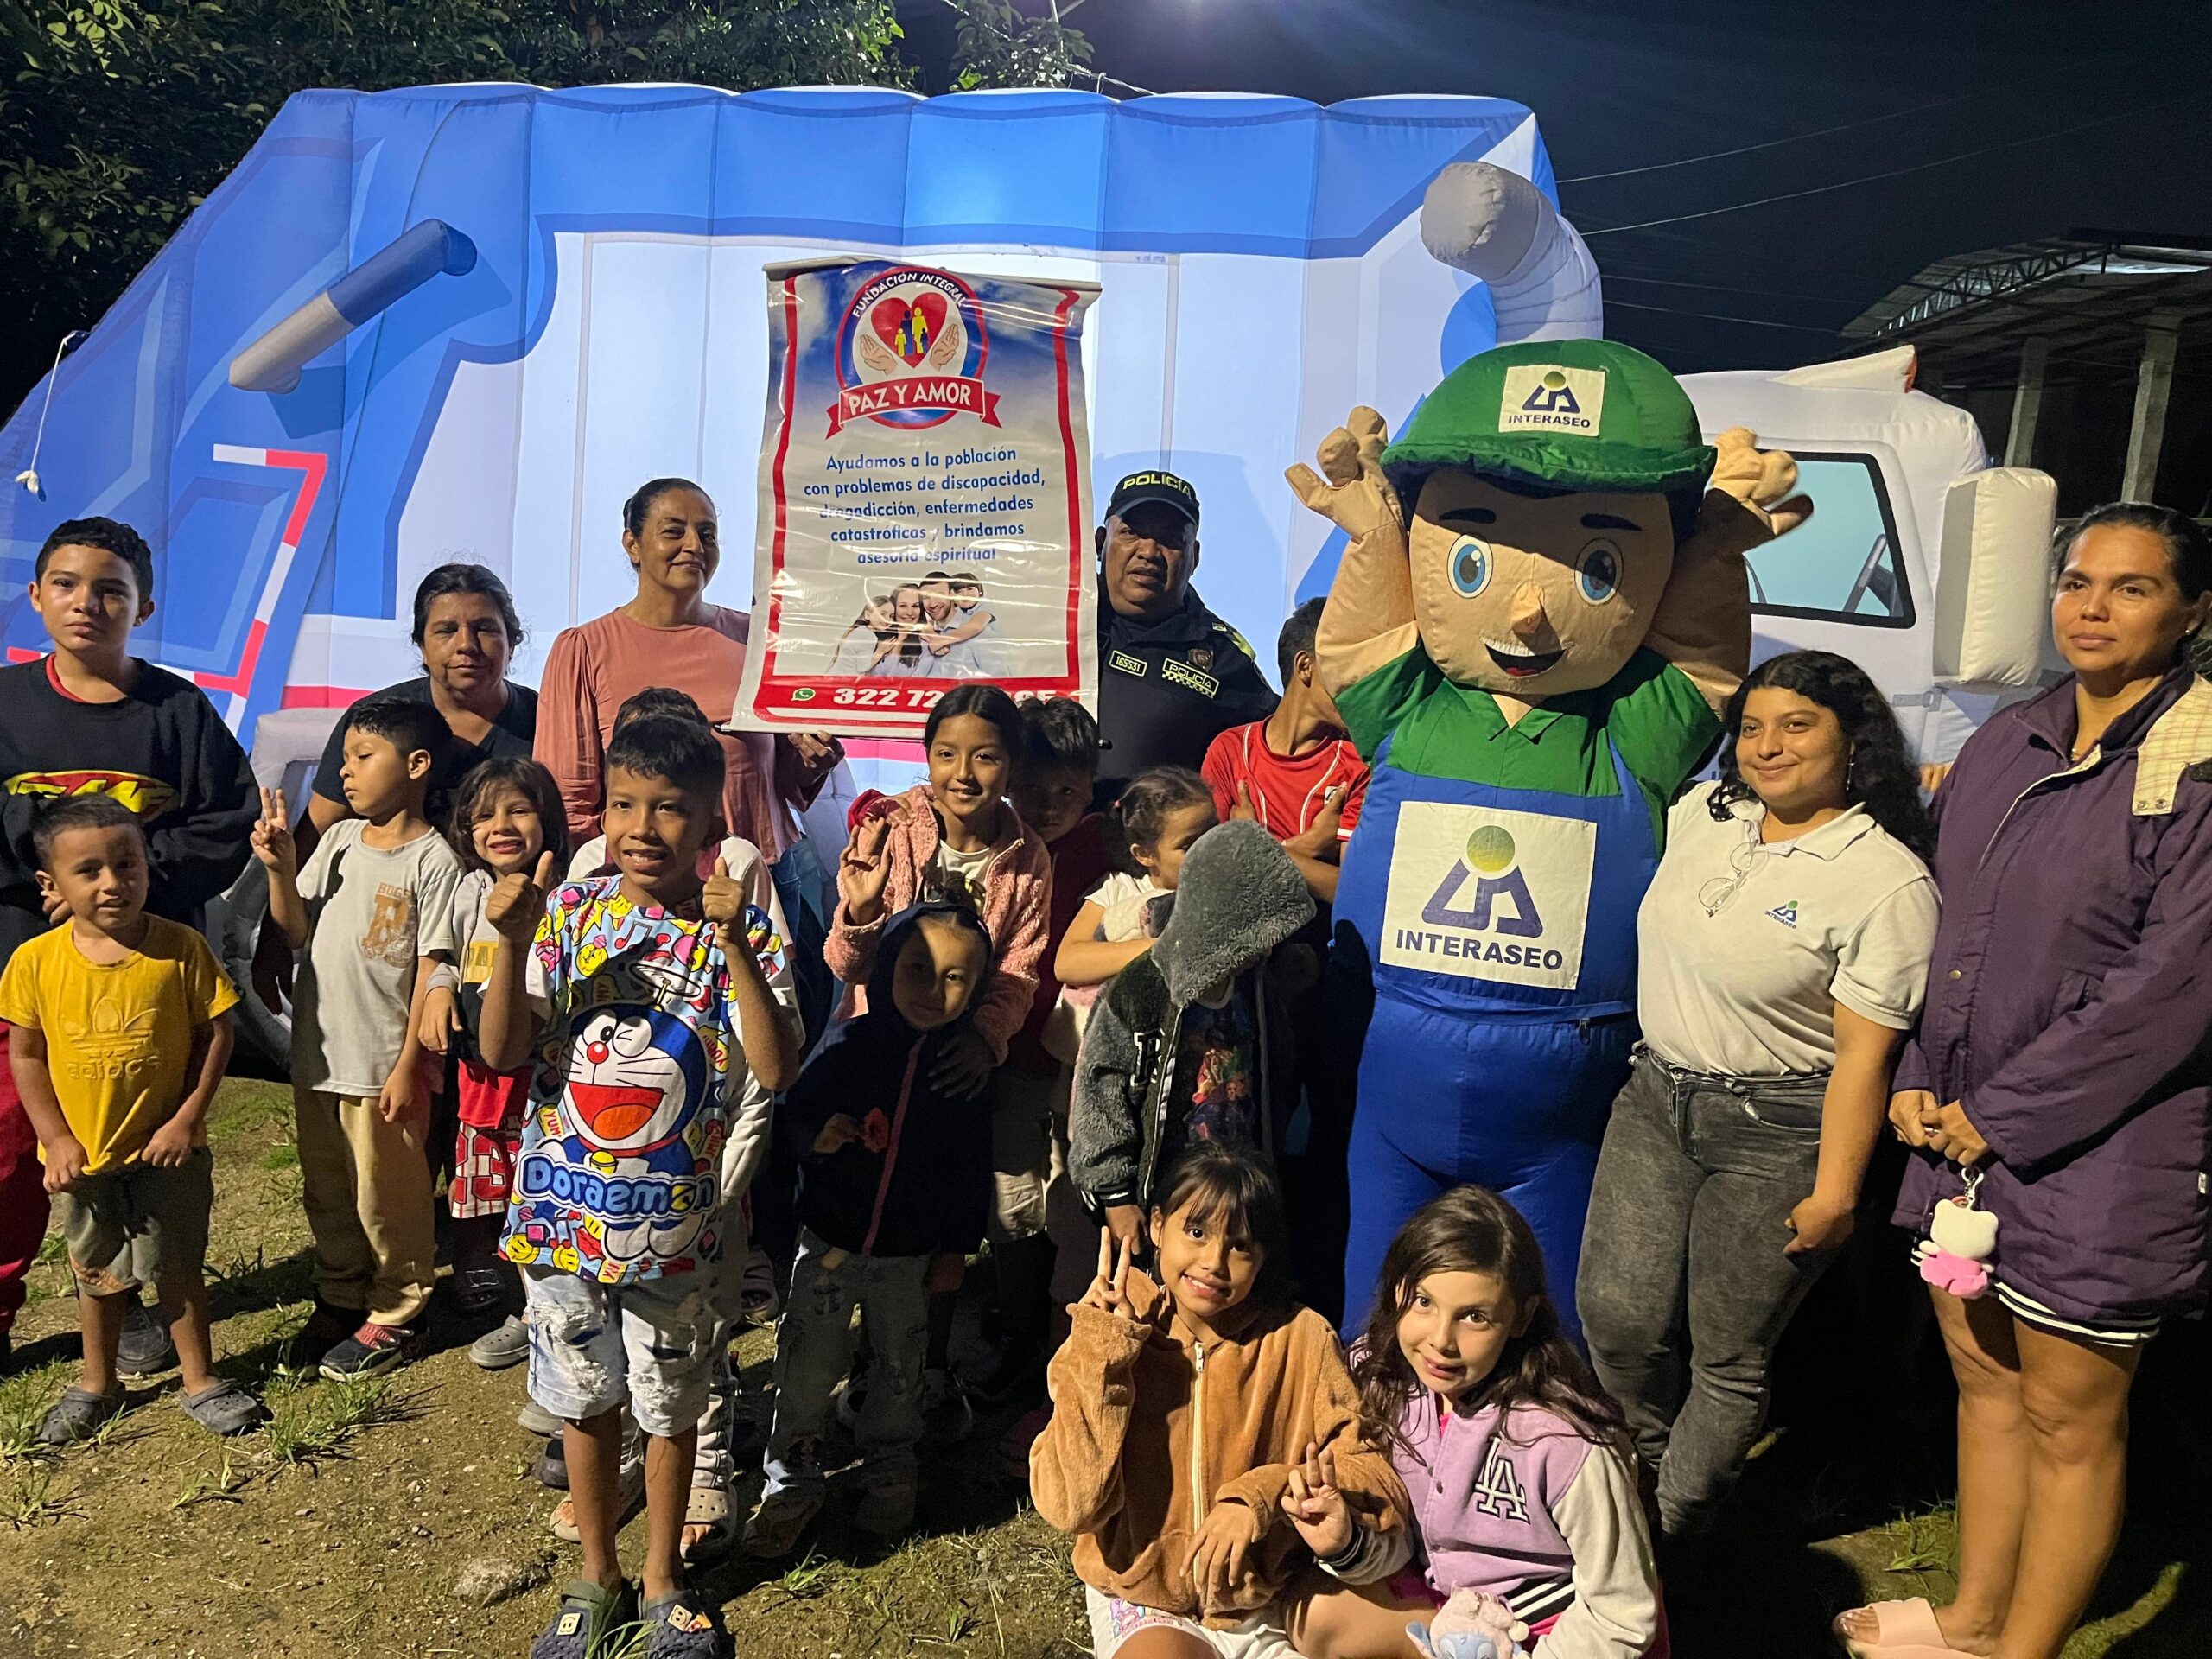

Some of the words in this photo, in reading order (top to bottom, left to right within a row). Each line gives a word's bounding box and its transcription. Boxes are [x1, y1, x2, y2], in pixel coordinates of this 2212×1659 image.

[851, 271, 918, 318] FUNDACIÓN
[919, 273, 967, 308] INTEGRAL
[848, 388, 890, 416] PAZ
[893, 384, 908, 404] Y
[912, 381, 971, 406] AMOR
[1508, 414, 1591, 429] INTERASEO
[826, 454, 906, 474] Ayudamos
[911, 456, 920, 467] a
[925, 451, 939, 466] la
[945, 446, 1016, 469] población
[804, 485, 830, 496] con
[835, 477, 912, 498] problemas
[918, 475, 936, 490] de
[941, 467, 1045, 491] discapacidad,
[1123, 474, 1192, 500] POLICÍA
[925, 494, 1034, 514] enfermedades
[830, 524, 926, 542] catastróficas
[944, 522, 1025, 537] brindamos
[925, 547, 995, 564] espiritual
[1169, 664, 1211, 689] POLICÍA
[833, 688, 899, 706] 322
[907, 690, 945, 709] 72
[1396, 929, 1563, 970] INTERASEO
[518, 1159, 714, 1211] Doraemon
[1473, 1436, 1531, 1525] LA
